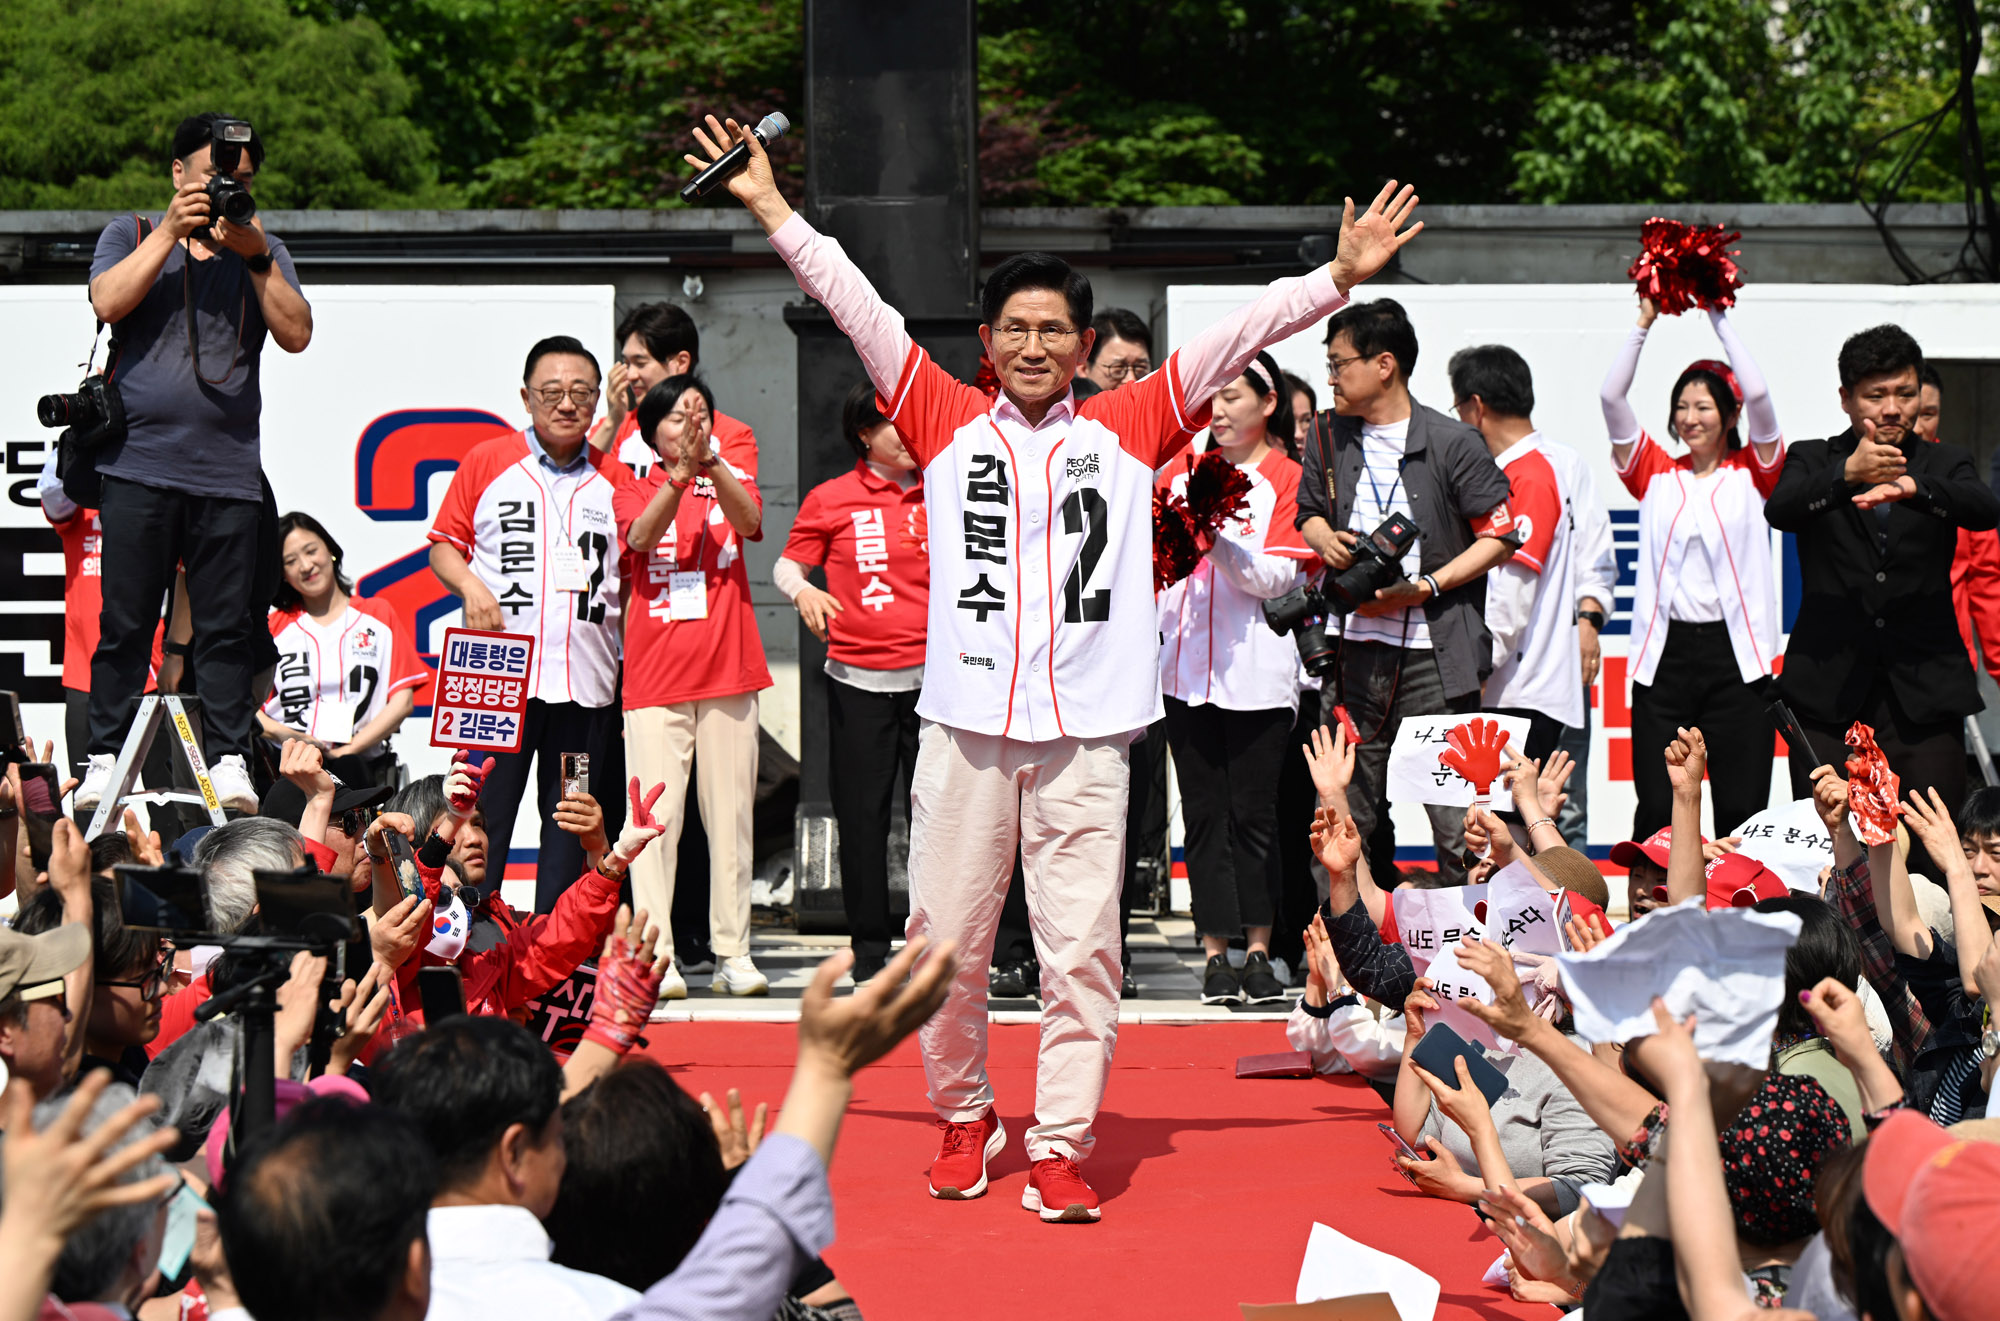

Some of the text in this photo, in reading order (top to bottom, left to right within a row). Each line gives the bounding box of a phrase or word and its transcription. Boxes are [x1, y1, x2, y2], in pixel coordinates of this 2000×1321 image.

[1066, 453, 1100, 468] PEOPLE
[1066, 463, 1100, 478] POWER
[957, 454, 1009, 622] 김문수
[498, 501, 535, 616] 김문수
[850, 508, 895, 612] 김문수
[1062, 487, 1111, 623] 2
[449, 641, 526, 673] 대통령은
[962, 656, 993, 667] 국민의힘
[444, 675, 522, 708] 정정당당
[440, 711, 516, 742] 2 김문수
[1743, 824, 1775, 839] 나도
[1408, 929, 1433, 950] 나도
